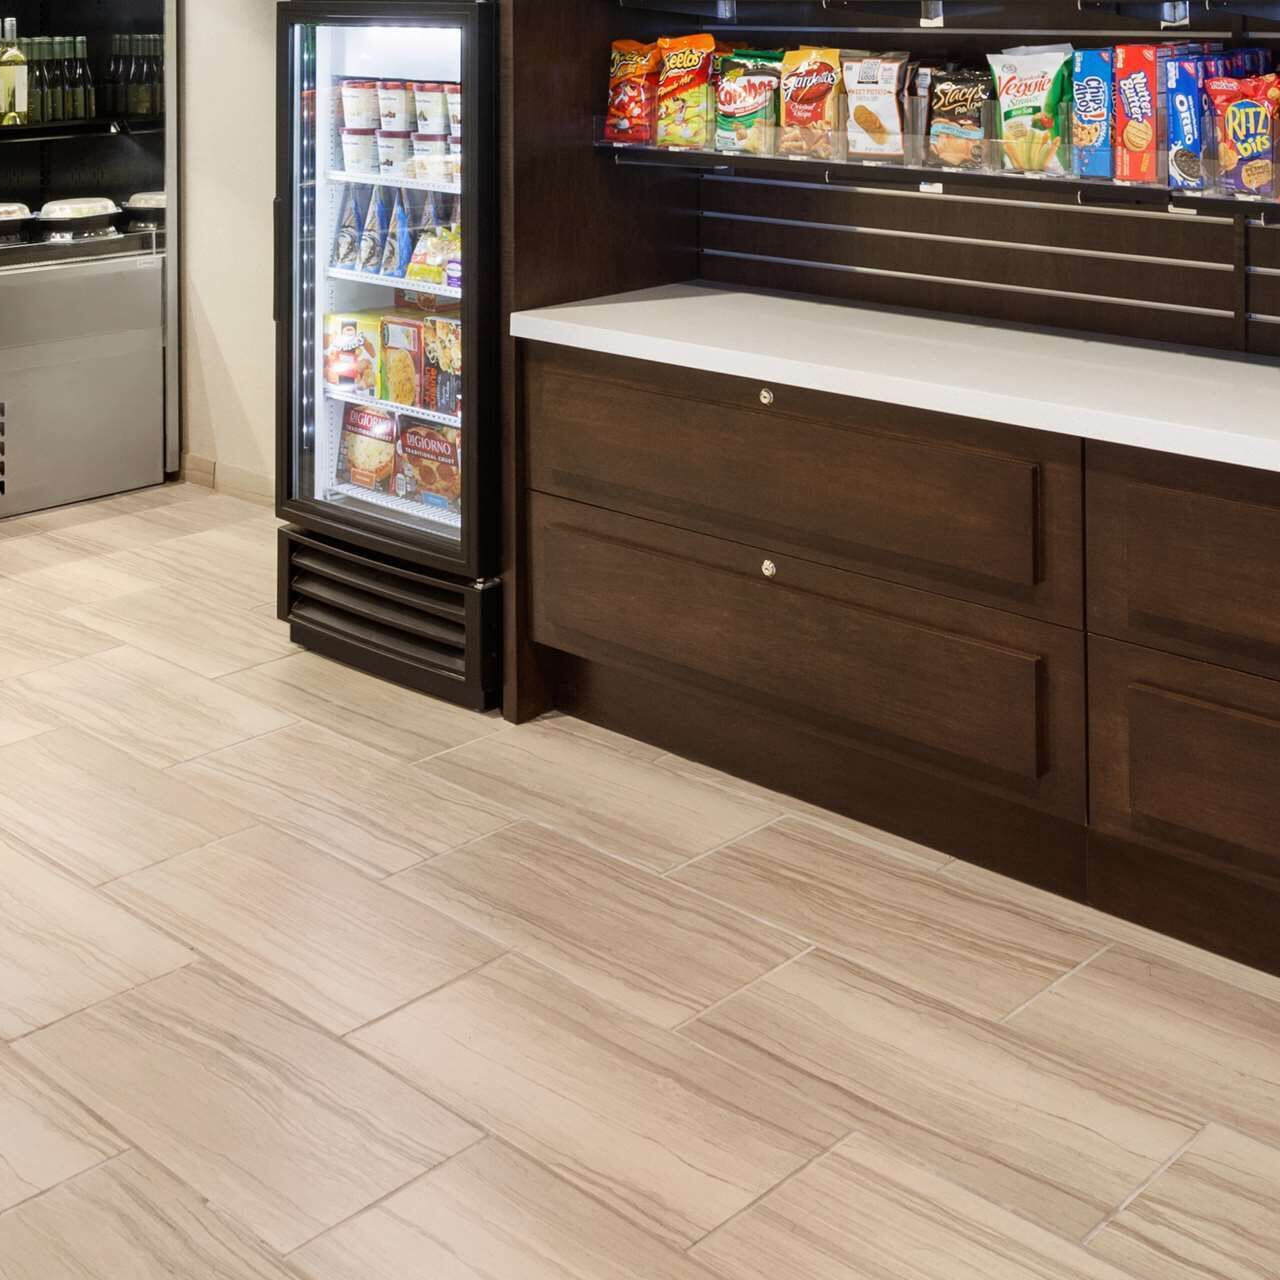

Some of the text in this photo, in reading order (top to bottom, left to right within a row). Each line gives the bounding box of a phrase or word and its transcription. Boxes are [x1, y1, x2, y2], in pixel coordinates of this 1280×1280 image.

[932, 82, 989, 111] Stacy's
[998, 75, 1052, 97] Veggie
[1085, 78, 1104, 112] Chips
[1120, 79, 1142, 121] Butter
[1132, 72, 1151, 116] Nutter
[1176, 95, 1193, 144] OREO
[1226, 107, 1268, 142] RITZ
[1237, 135, 1271, 160] bits
[407, 430, 451, 455] DIGIORNO
